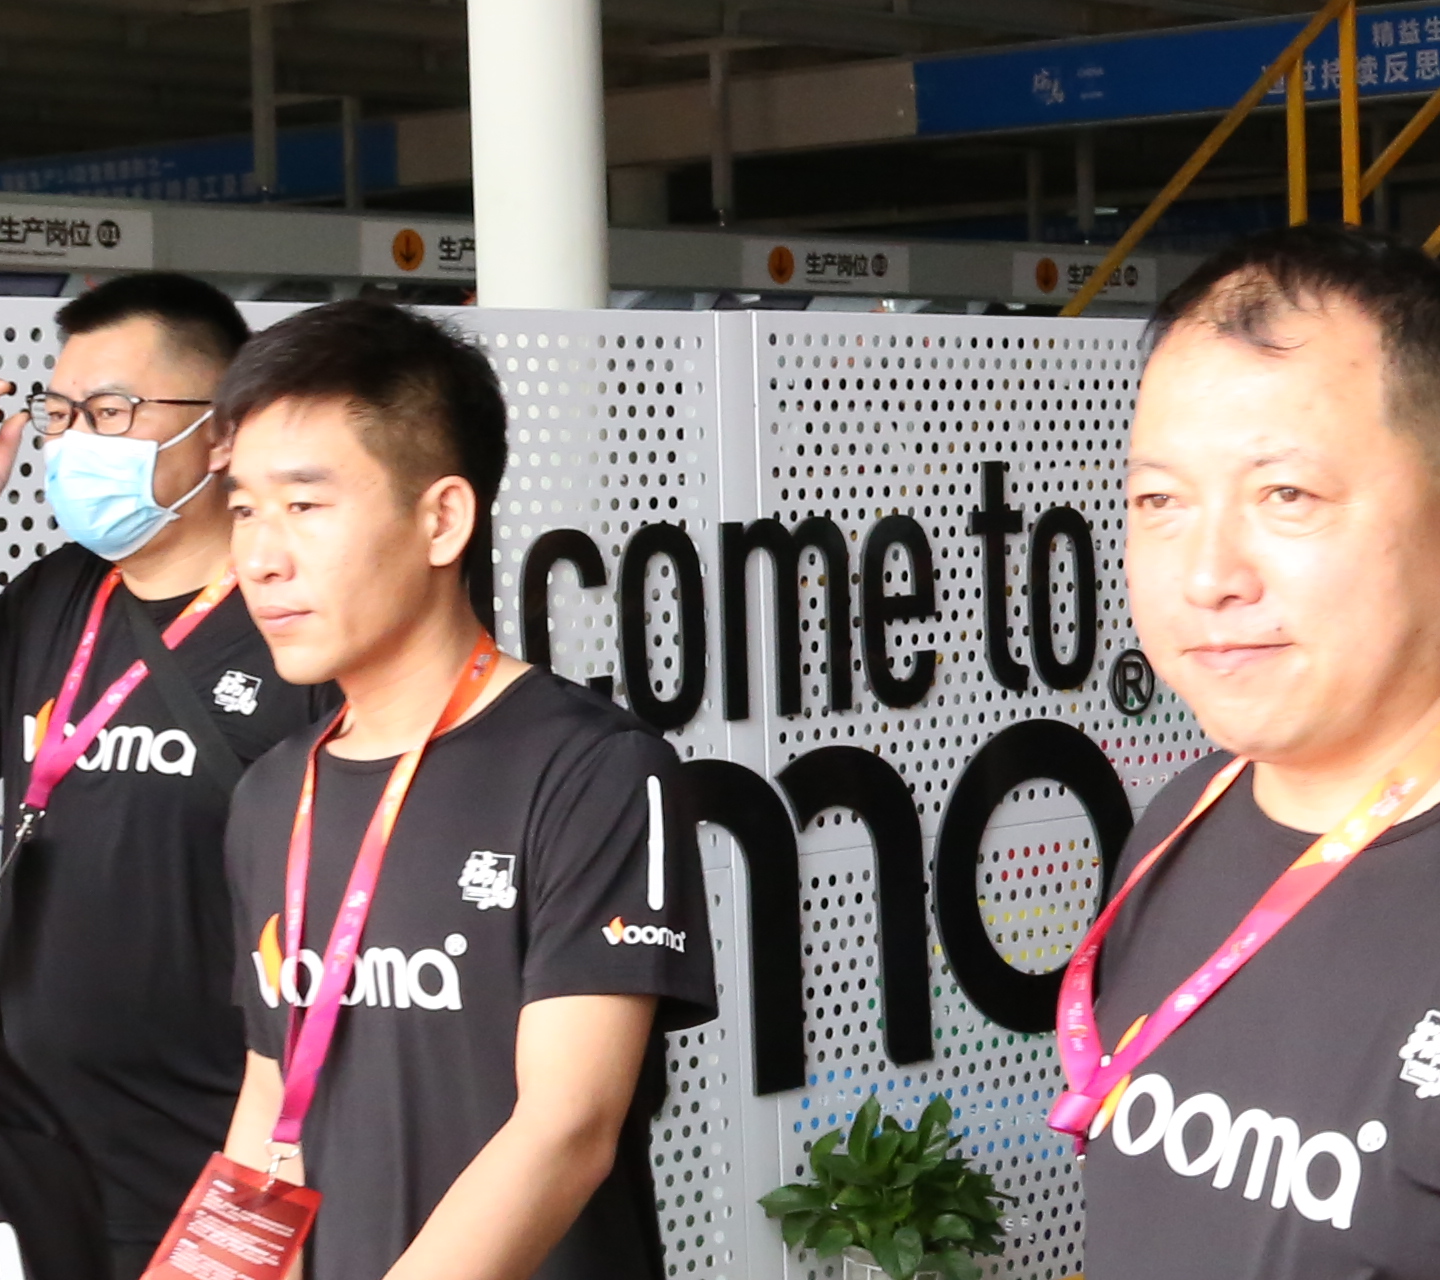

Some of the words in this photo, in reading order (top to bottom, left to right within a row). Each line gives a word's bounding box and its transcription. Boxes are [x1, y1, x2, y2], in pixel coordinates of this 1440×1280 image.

[806, 252, 869, 277] 生产岗位
[1067, 265, 1122, 288] 生产位
